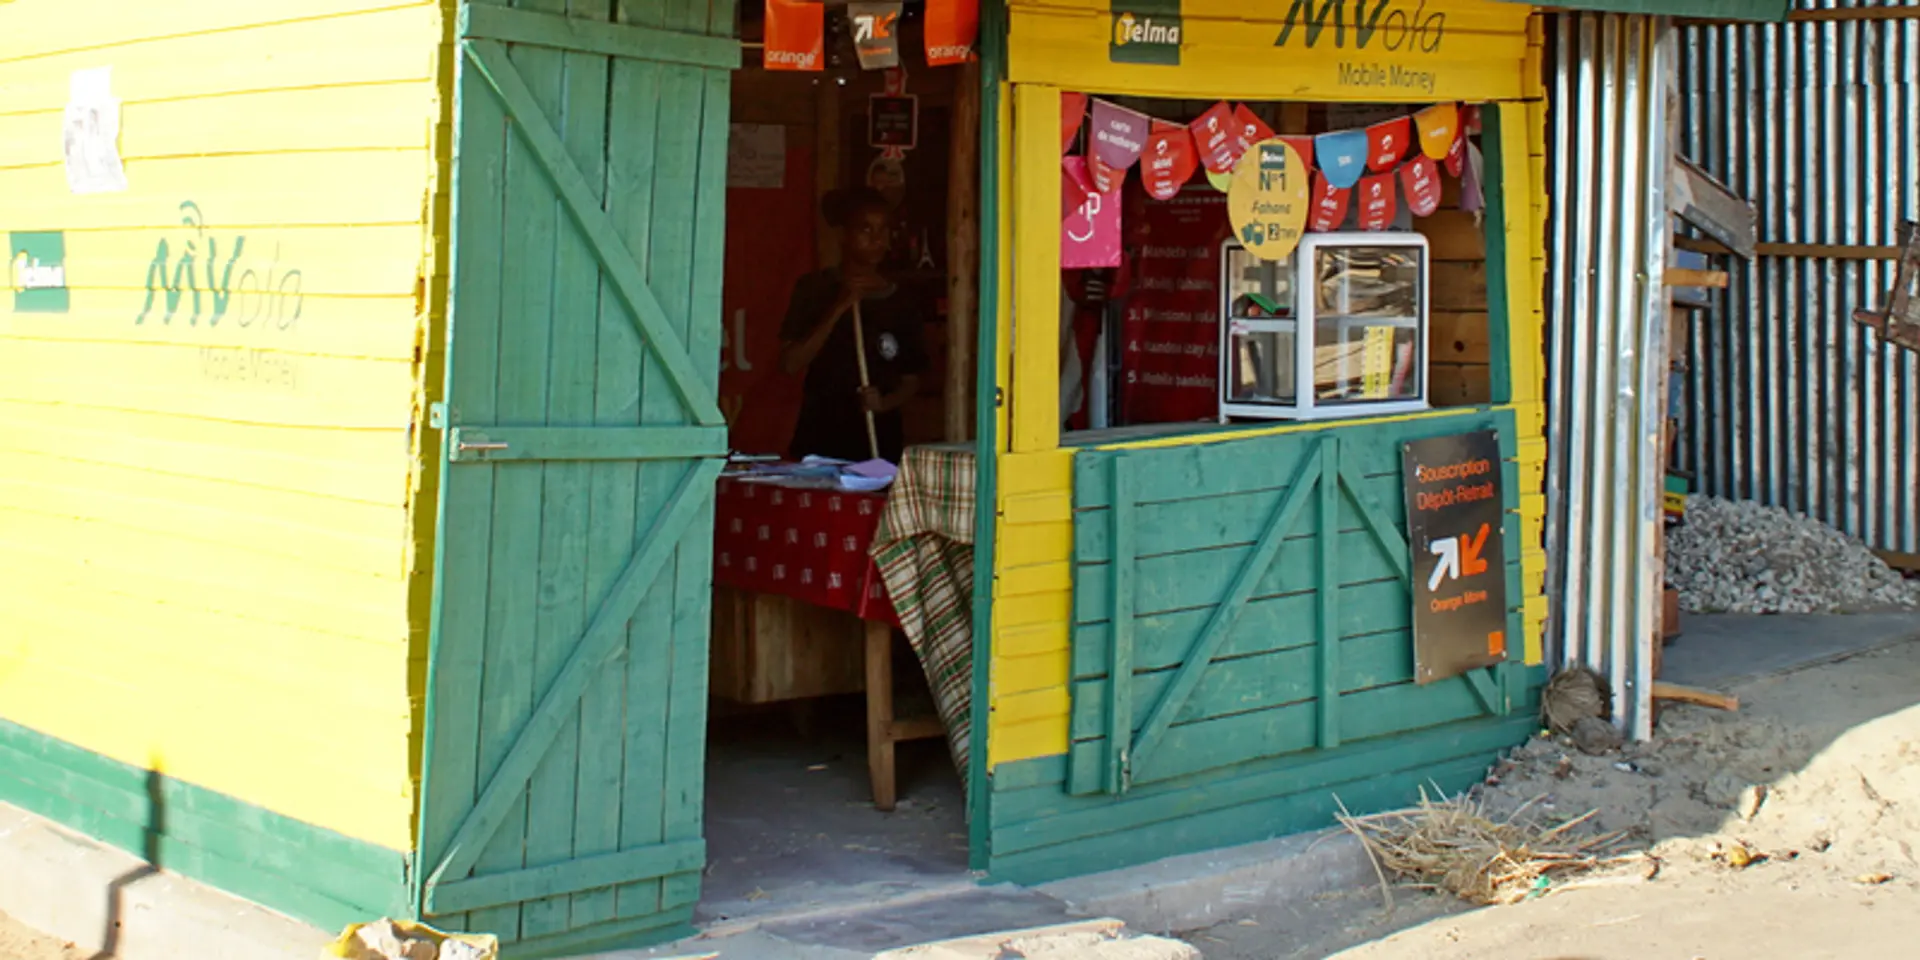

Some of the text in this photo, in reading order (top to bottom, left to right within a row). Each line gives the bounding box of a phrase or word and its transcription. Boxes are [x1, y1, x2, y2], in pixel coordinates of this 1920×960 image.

[1121, 18, 1179, 45] Telma
[766, 50, 819, 70] orange
[1338, 62, 1437, 95] Mobile Money
[1418, 460, 1490, 483] Souscription
